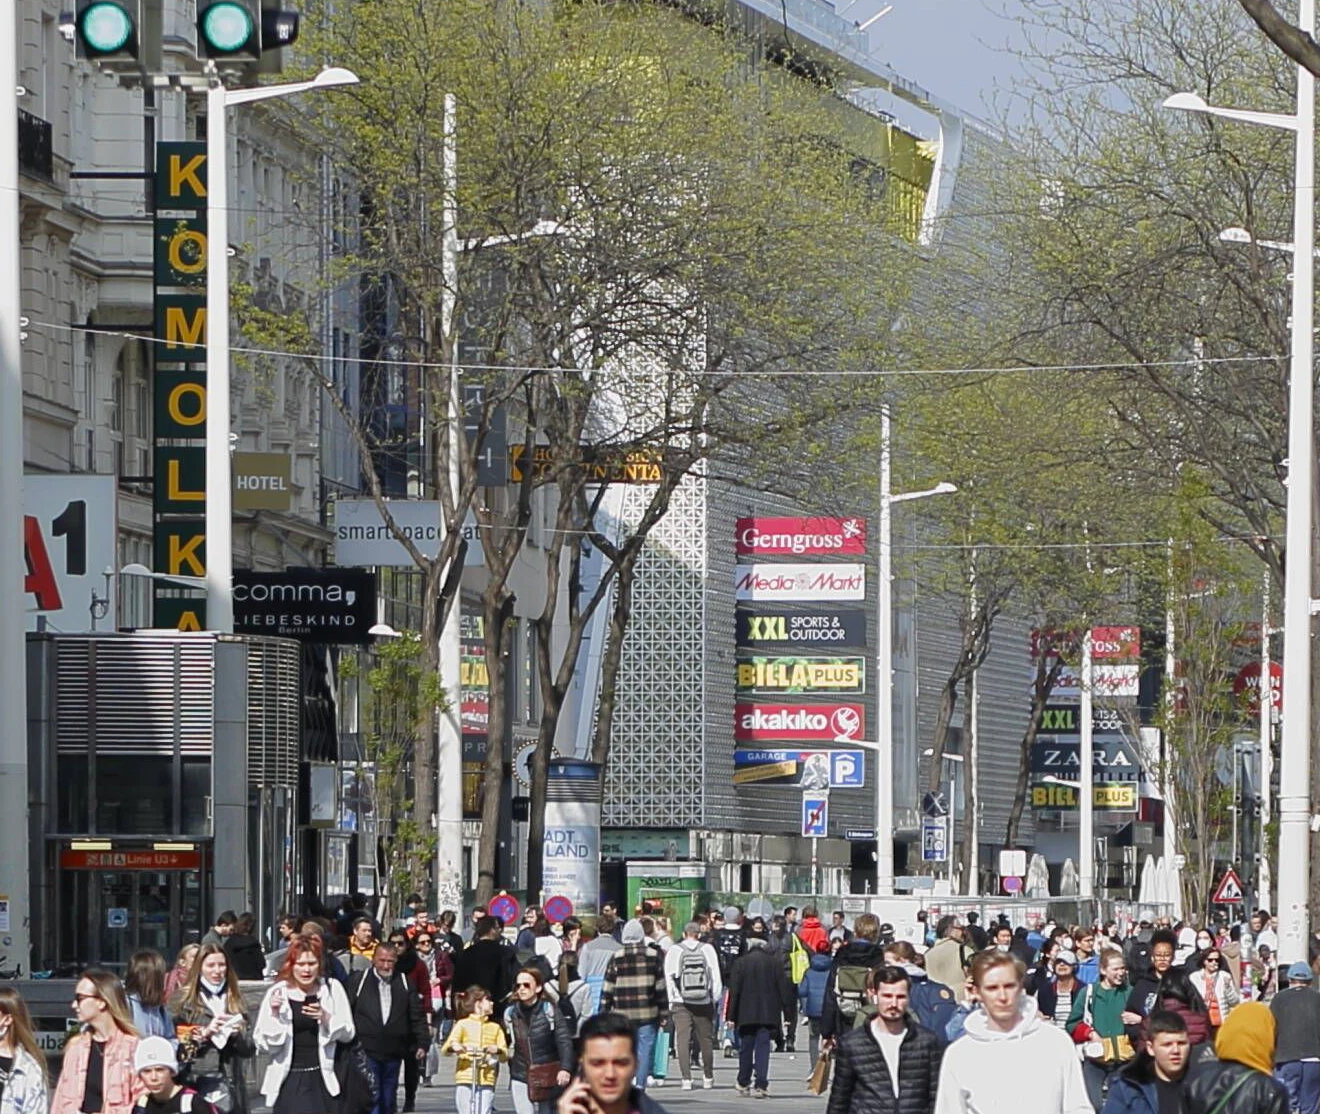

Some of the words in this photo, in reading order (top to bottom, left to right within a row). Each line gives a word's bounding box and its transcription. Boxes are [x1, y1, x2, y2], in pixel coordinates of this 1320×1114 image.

[237, 476, 287, 491] HOTEL
[742, 528, 844, 554] Gerngross
[736, 573, 795, 591] Media
[809, 573, 863, 591] Markt
[233, 614, 356, 626] LIEBESKIND
[747, 616, 789, 640] XXL
[791, 616, 830, 629] SPORTS
[831, 616, 841, 629] &
[790, 629, 846, 640] OUTDOOR
[738, 662, 808, 688] BILLA
[814, 669, 854, 682] PLUS
[742, 709, 828, 730] akakiko
[1041, 709, 1076, 730] XXL
[747, 752, 787, 761] GARAGE
[1043, 750, 1133, 766] ZARA
[1032, 786, 1077, 807] BILL
[1095, 790, 1130, 803] PLUS
[127, 854, 152, 865] Linie
[154, 854, 168, 865] U3
[546, 844, 589, 858] LAND
